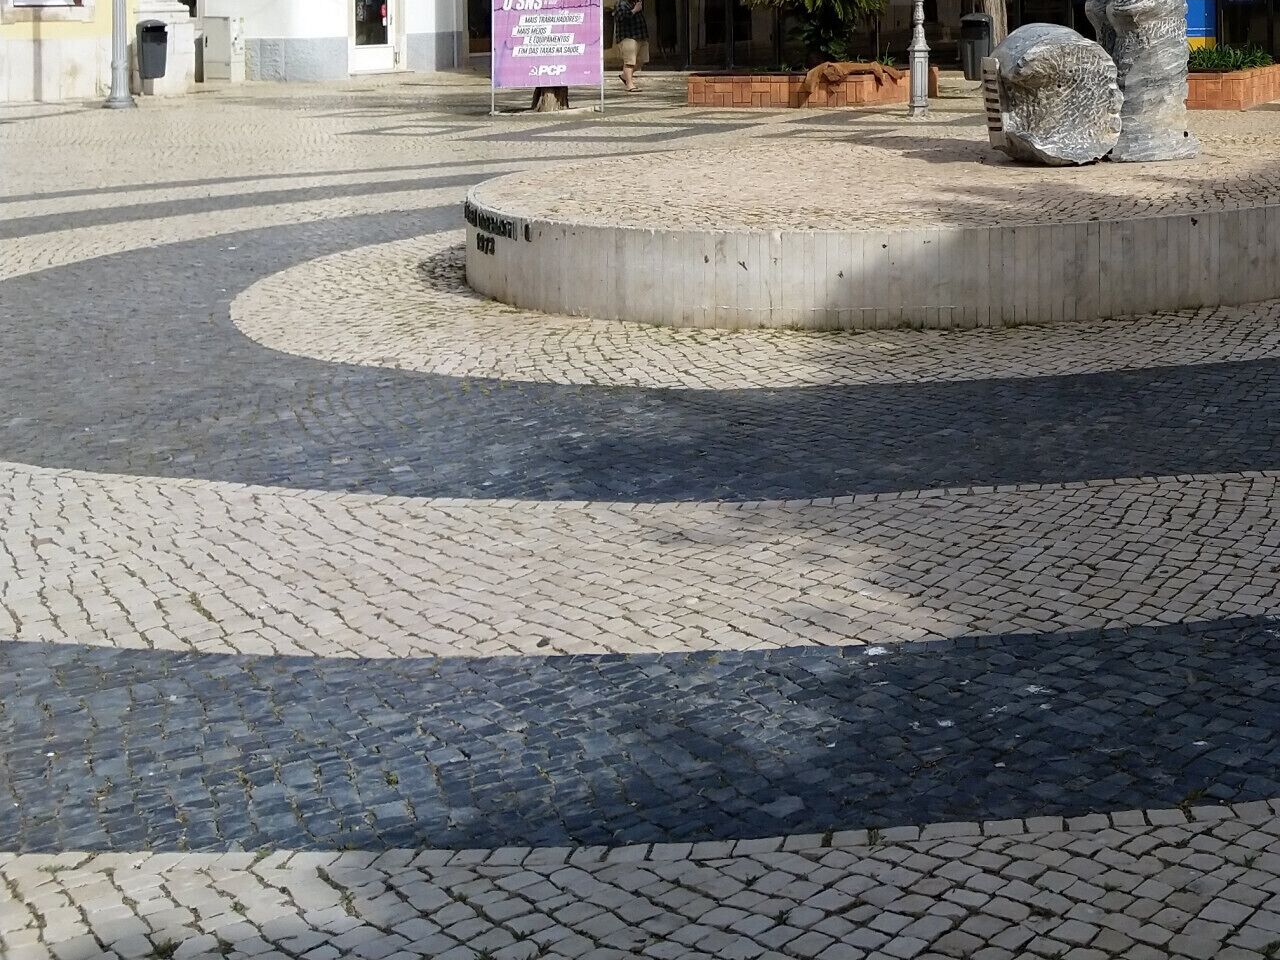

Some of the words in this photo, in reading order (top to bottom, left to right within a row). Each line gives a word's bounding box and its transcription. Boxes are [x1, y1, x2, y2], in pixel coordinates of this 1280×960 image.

[525, 16, 538, 24] MAIS
[533, 35, 570, 44] EQUIPAMENTOS
[539, 46, 555, 54] TAXAS
[539, 64, 567, 76] PCP
